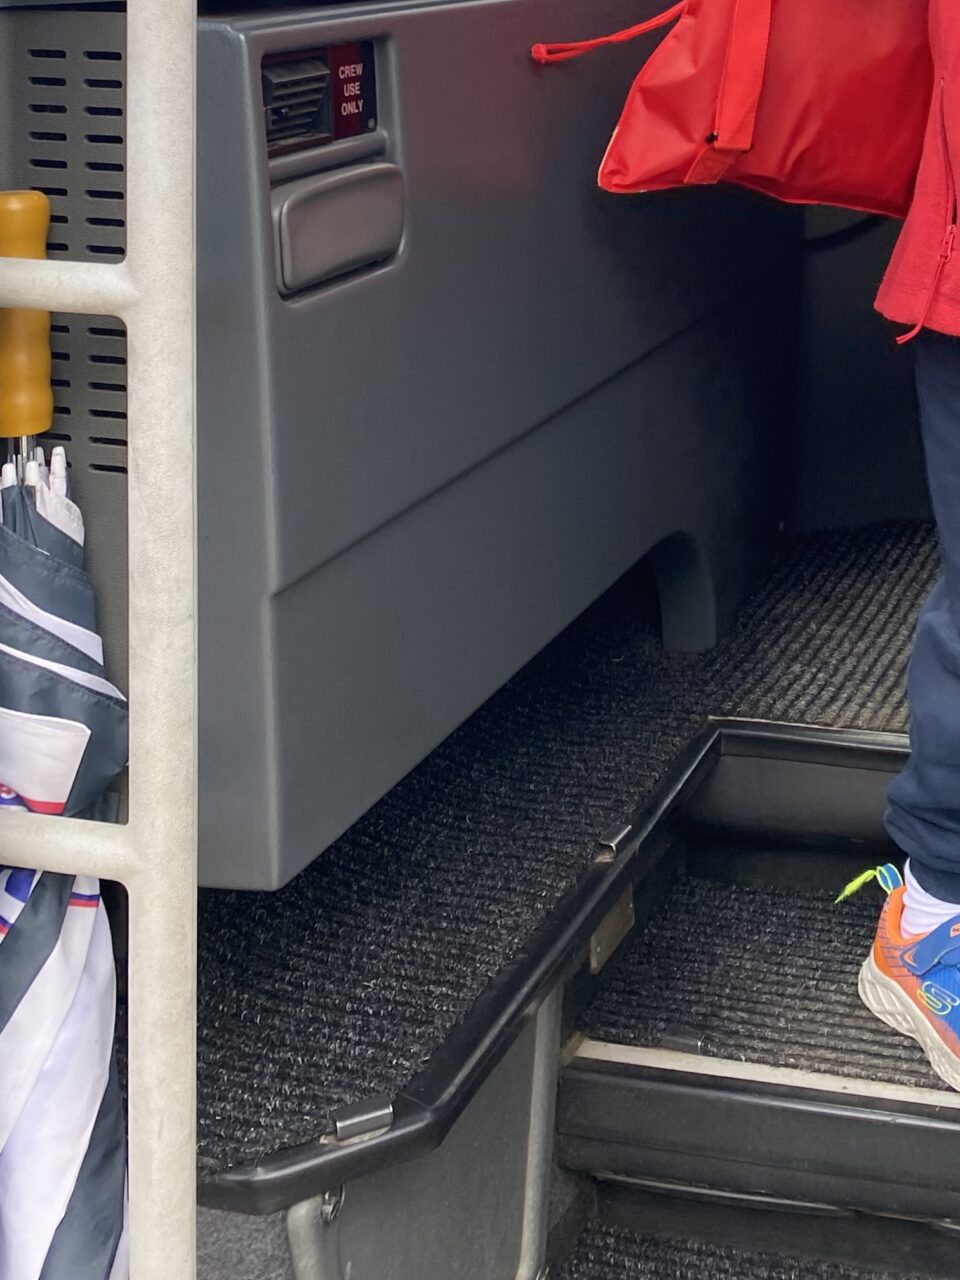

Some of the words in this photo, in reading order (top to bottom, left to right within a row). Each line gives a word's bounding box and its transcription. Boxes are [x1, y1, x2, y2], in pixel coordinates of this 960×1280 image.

[339, 63, 364, 79] CREW
[343, 82, 361, 97] USE
[341, 99, 364, 116] ONLY
